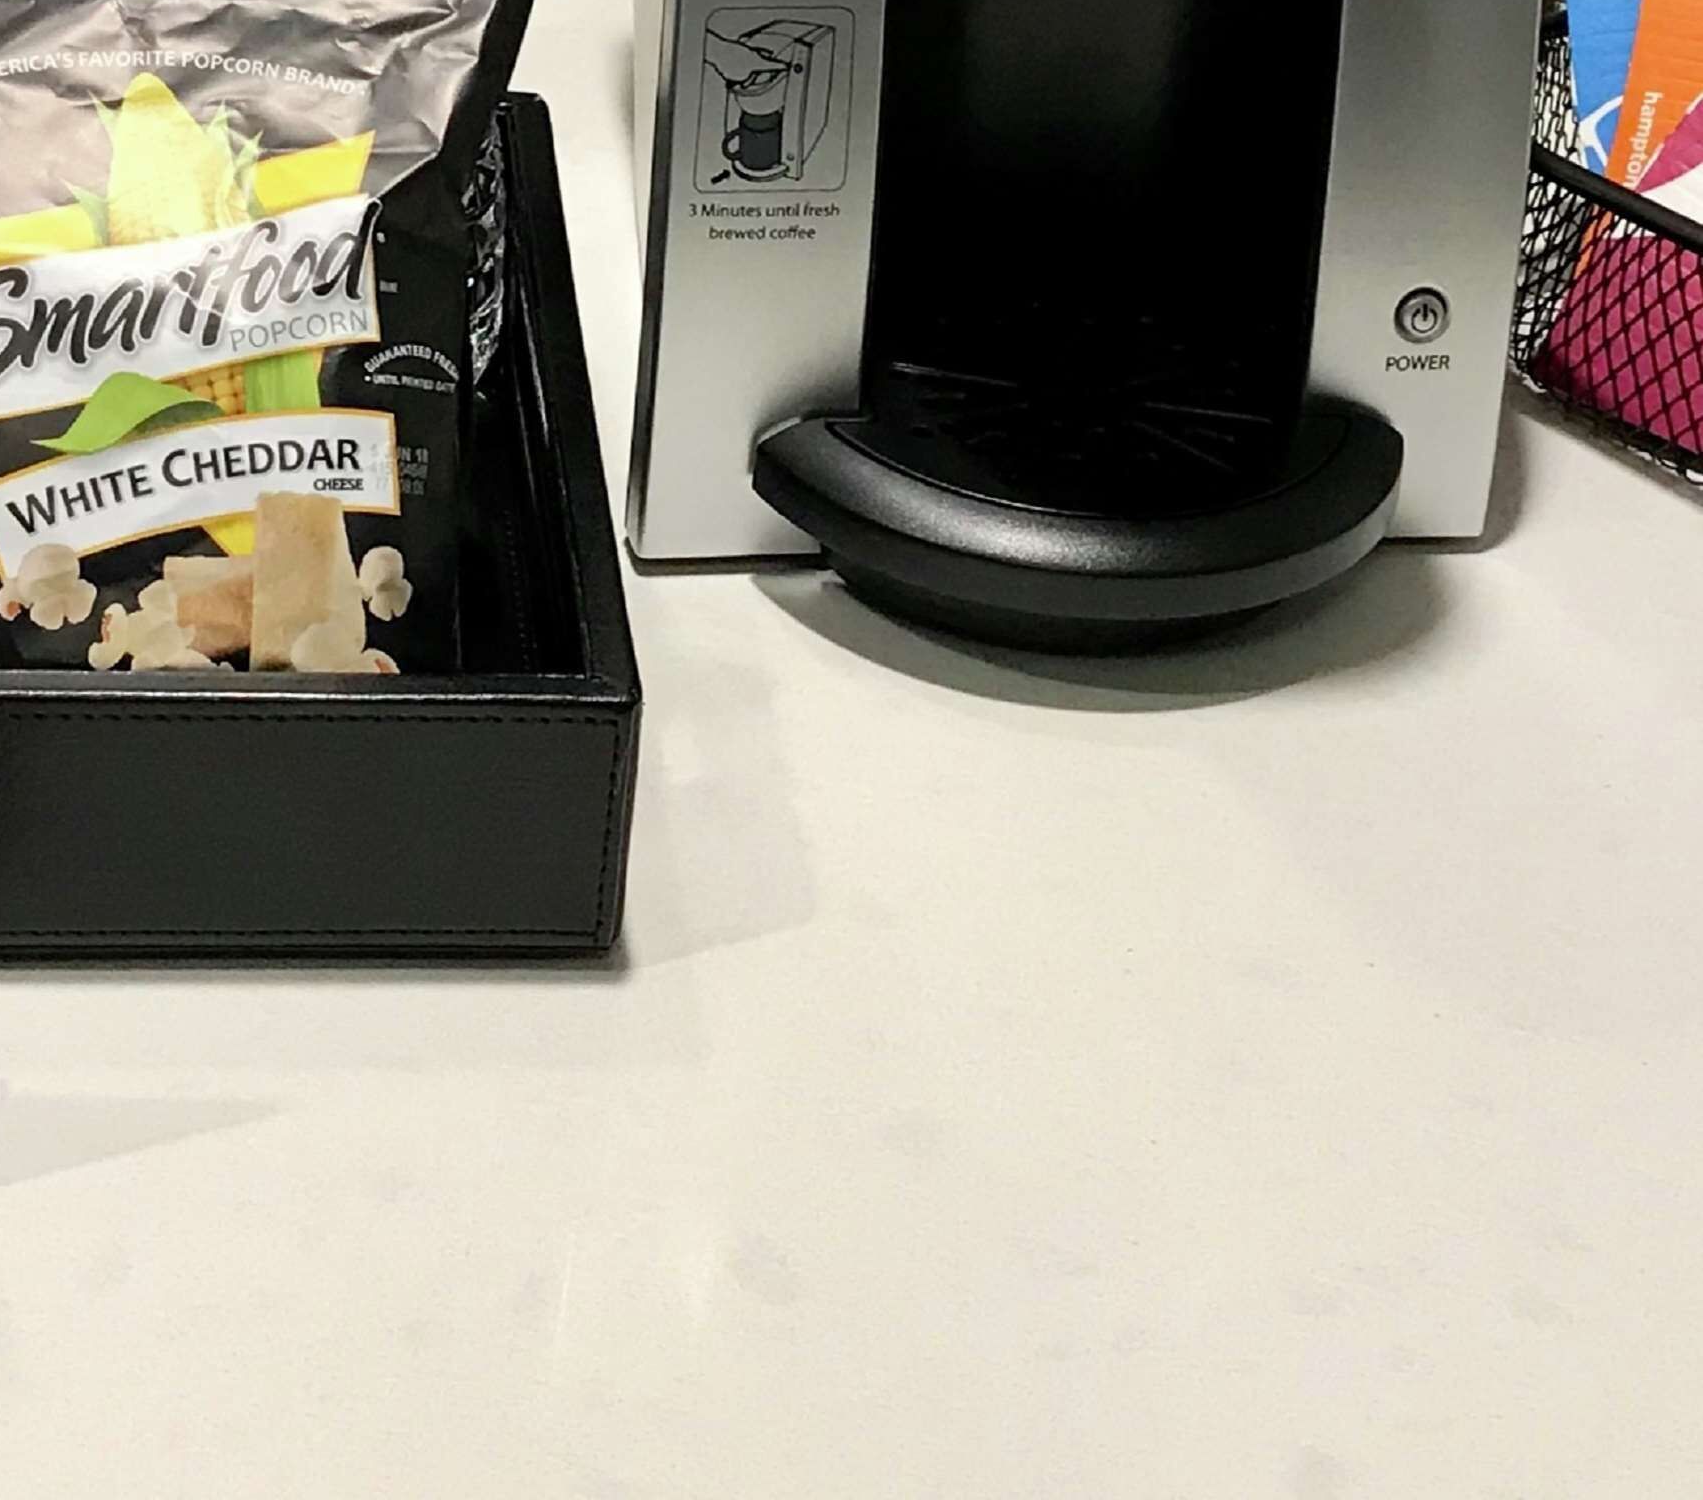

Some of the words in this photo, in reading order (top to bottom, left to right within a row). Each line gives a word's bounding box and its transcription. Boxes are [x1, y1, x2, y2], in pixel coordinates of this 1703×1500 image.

[77, 50, 176, 69] FAVORITE
[180, 51, 280, 79] POPCORN
[688, 204, 698, 217] 3
[701, 203, 762, 218] Minutes
[765, 203, 799, 217] until
[802, 202, 840, 217] fresh
[708, 225, 766, 240] brewed
[769, 225, 817, 240] coffee
[230, 308, 368, 352] POPCORN
[364, 343, 432, 374] GUARANTEED
[1385, 354, 1450, 372] POWER
[5, 463, 154, 535] WHITE
[161, 438, 361, 488] CHEDDAR
[313, 477, 364, 492] CHEESE
